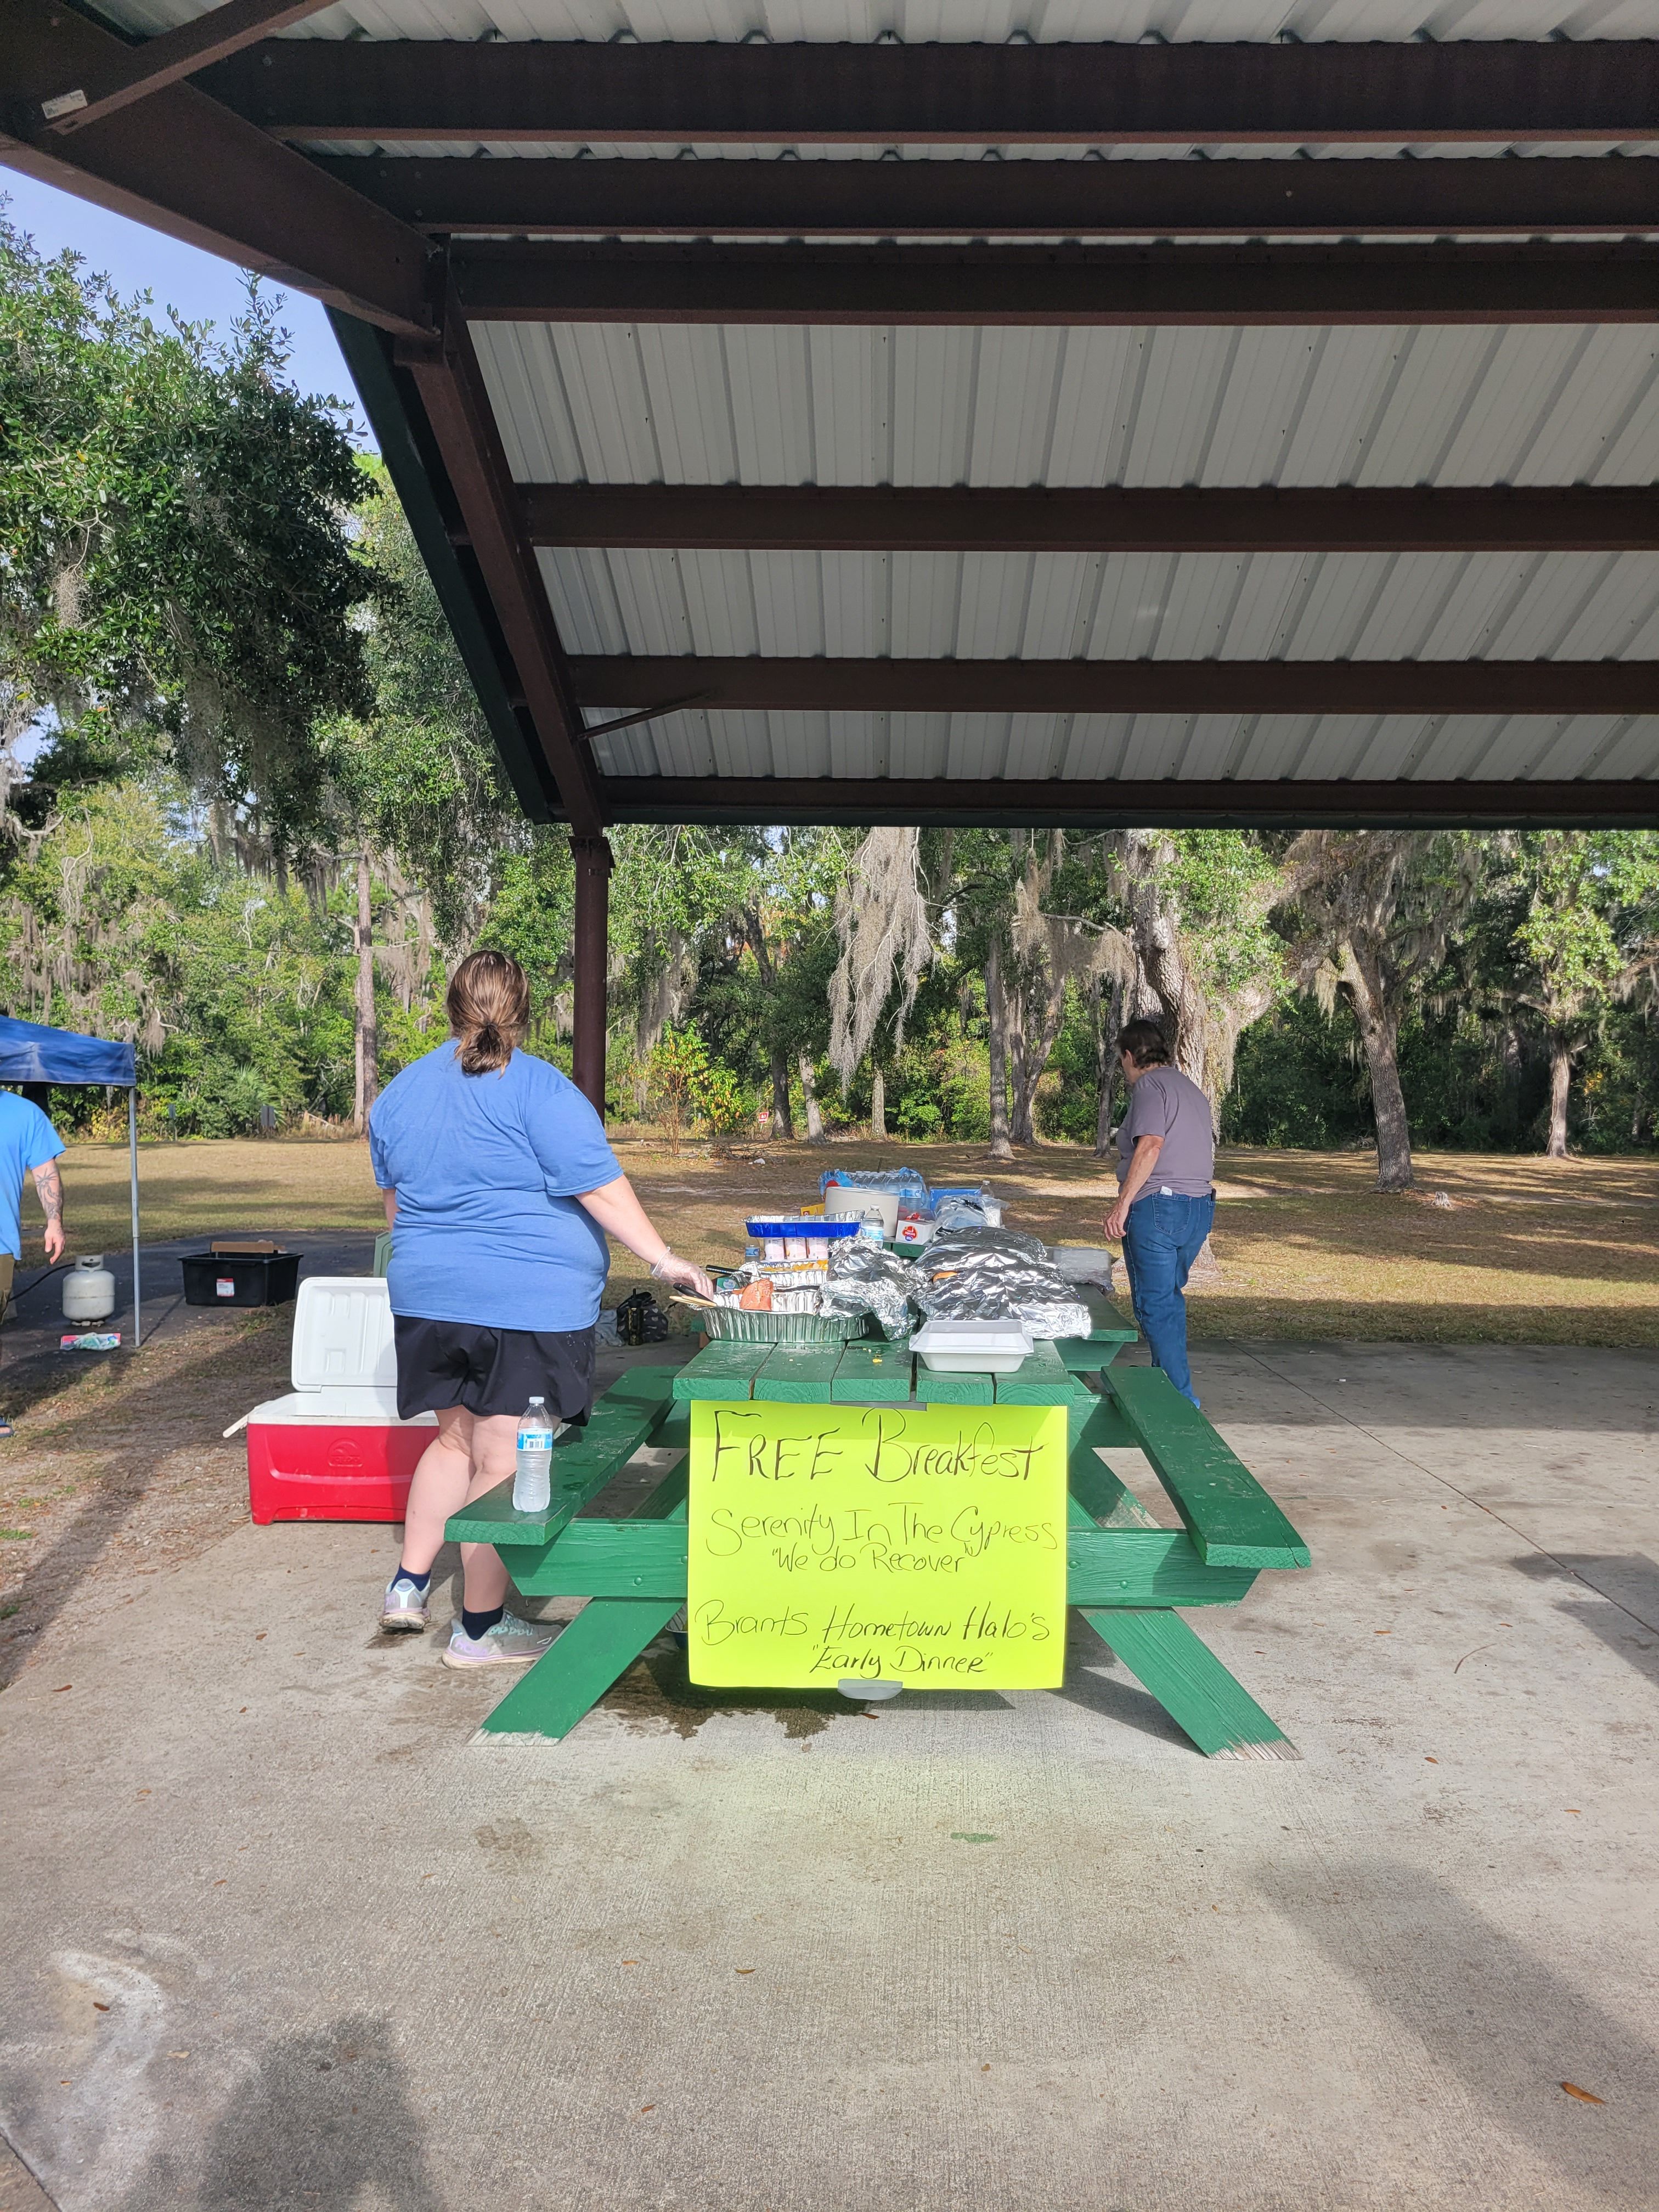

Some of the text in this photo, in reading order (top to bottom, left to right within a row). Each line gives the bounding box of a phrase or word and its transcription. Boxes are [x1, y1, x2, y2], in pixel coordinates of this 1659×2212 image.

[713, 1410, 844, 1482] FREE
[706, 1502, 1058, 1557] Serenity In The Cypress
[820, 1545, 856, 1572] do
[822, 1603, 951, 1643] Hometown
